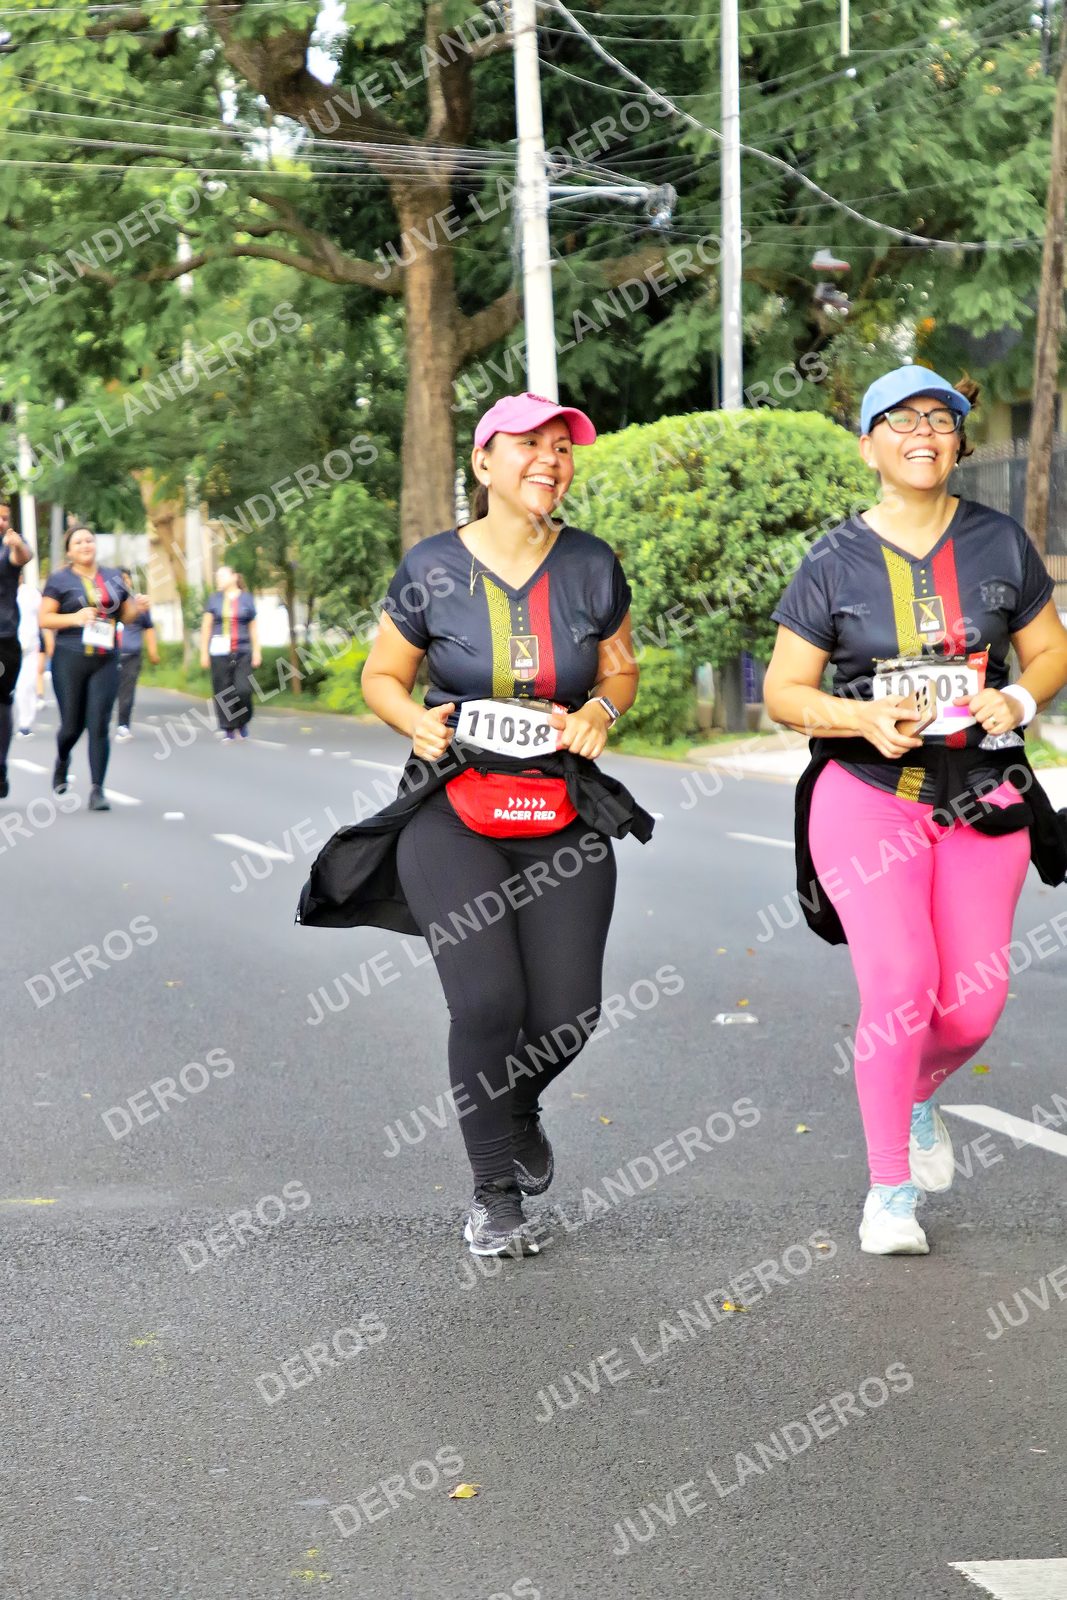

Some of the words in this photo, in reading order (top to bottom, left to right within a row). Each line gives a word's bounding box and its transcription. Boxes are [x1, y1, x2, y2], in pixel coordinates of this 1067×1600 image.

[467, 710, 551, 747] 11038
[494, 808, 532, 821] PACER
[533, 810, 556, 821] RED
